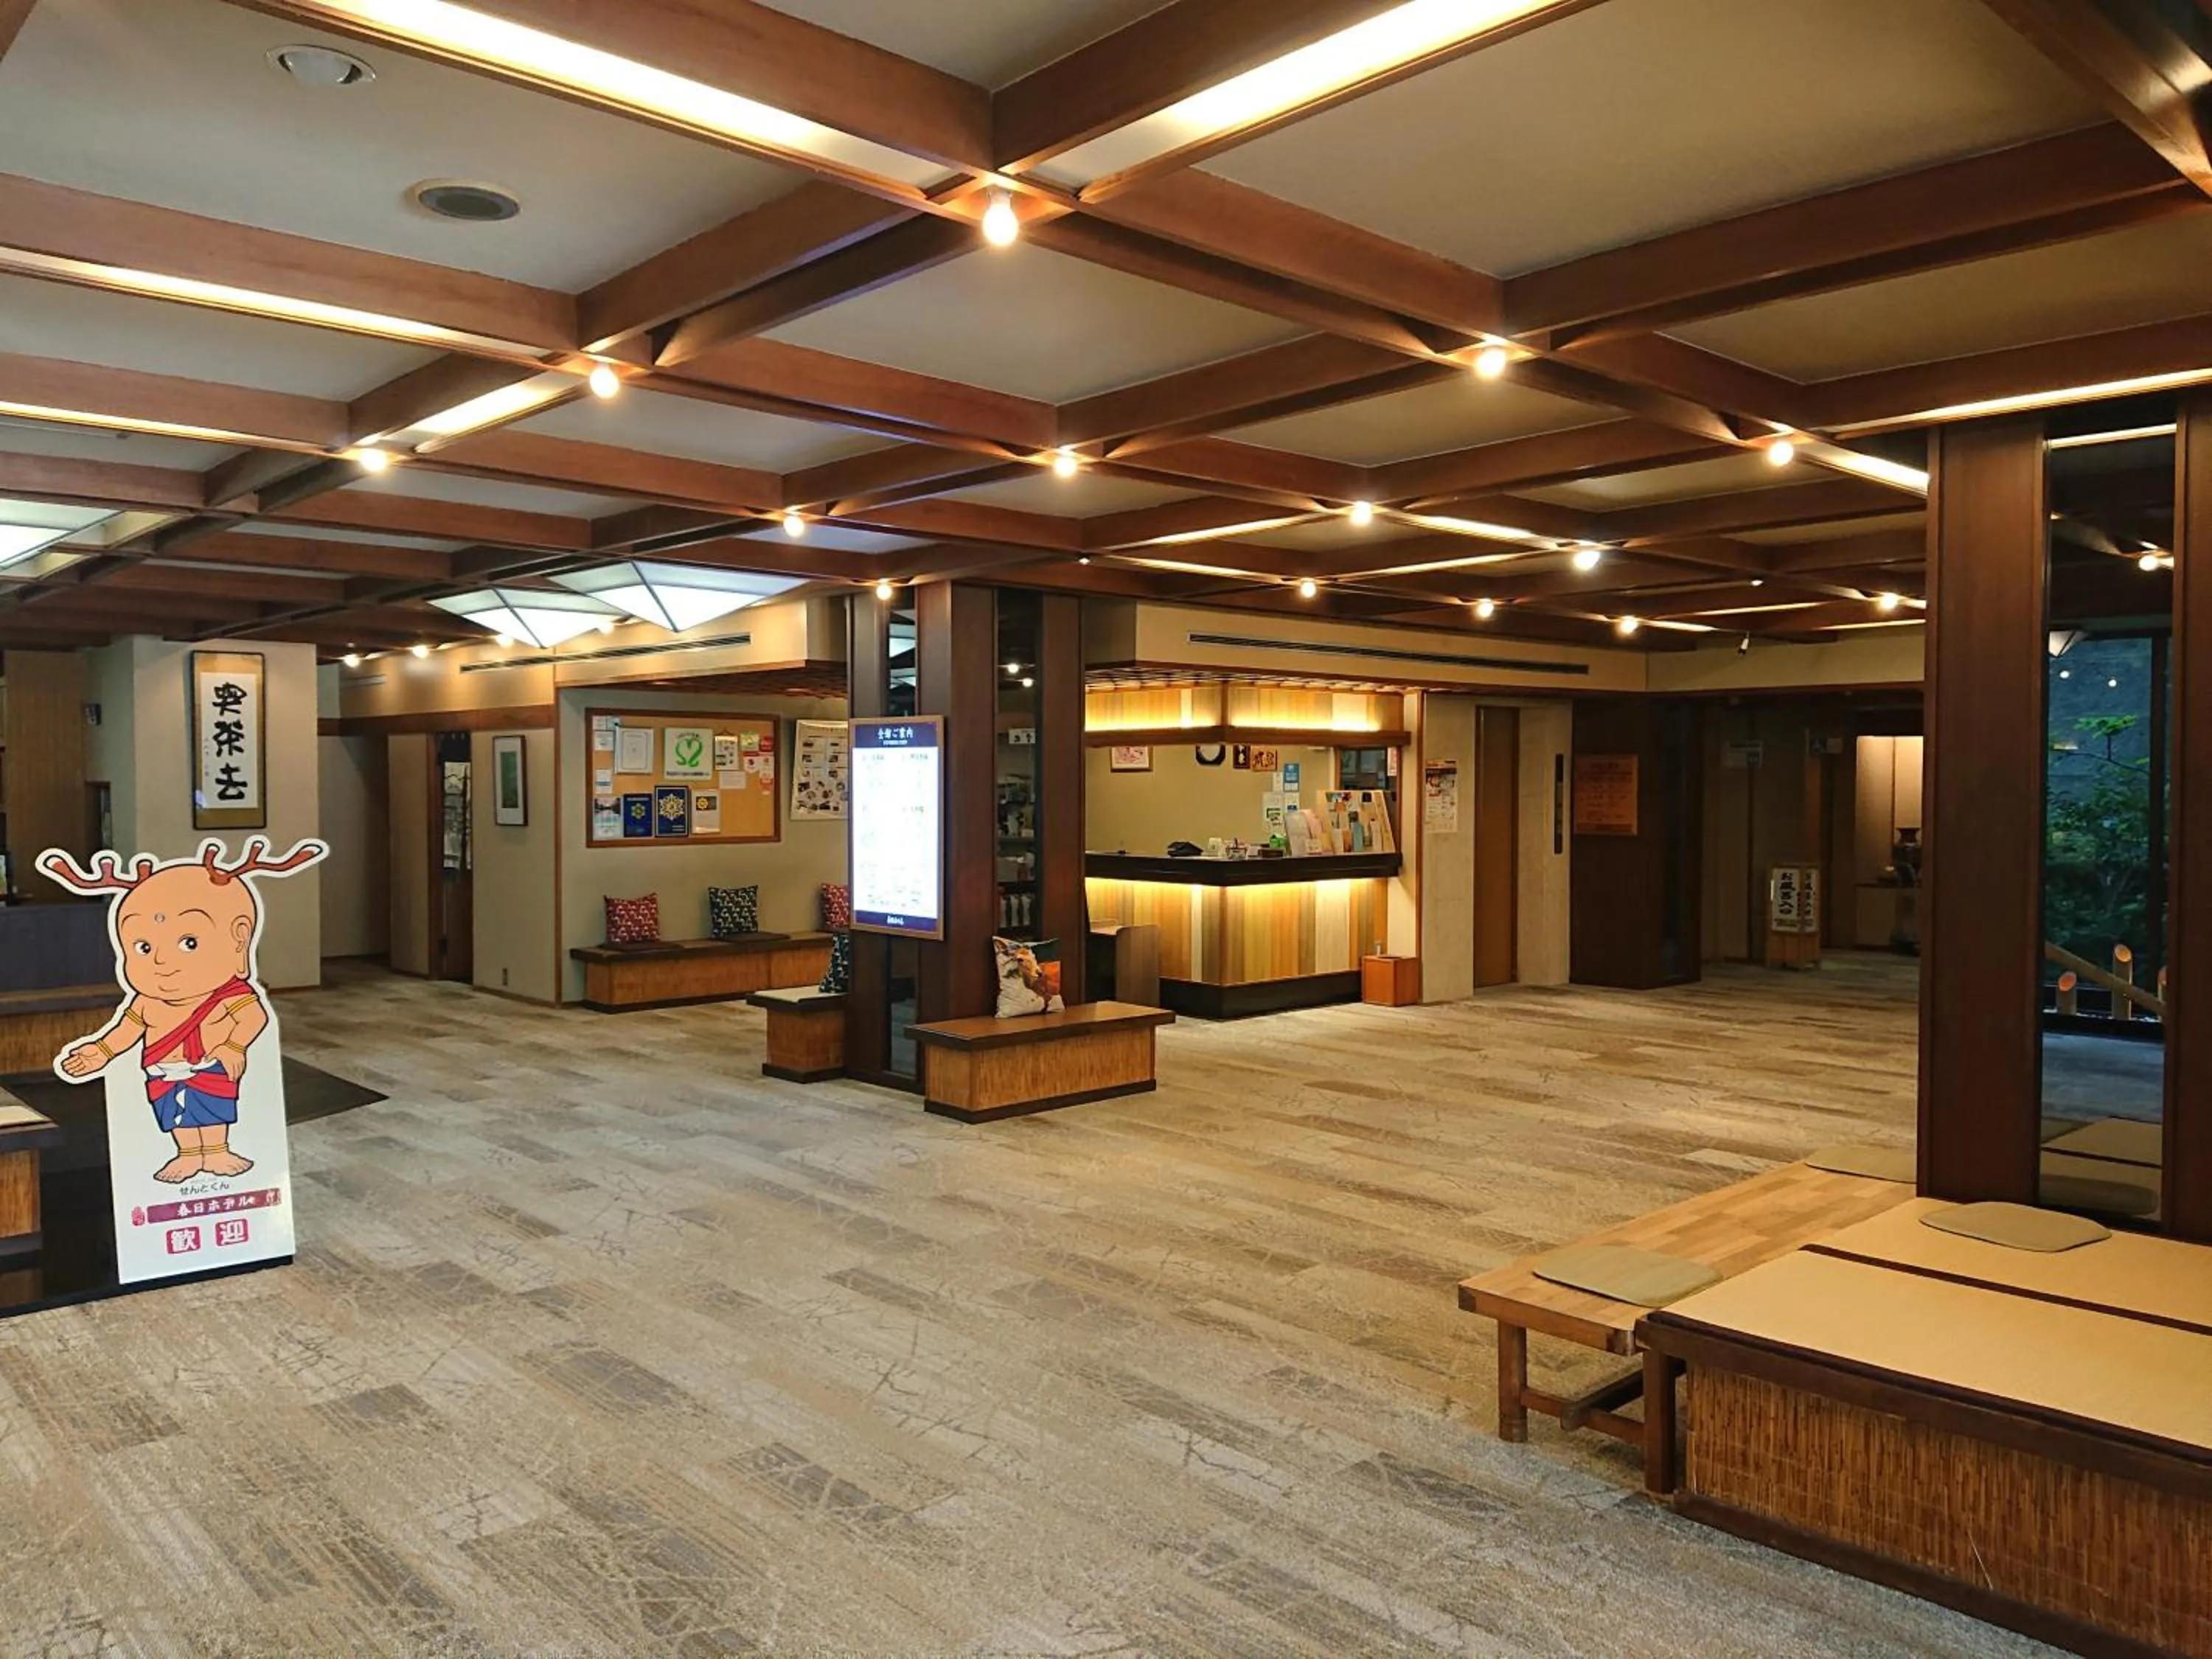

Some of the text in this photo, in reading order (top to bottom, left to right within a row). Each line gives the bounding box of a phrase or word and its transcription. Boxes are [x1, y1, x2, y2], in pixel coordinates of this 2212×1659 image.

[179, 1183, 230, 1196] せんとくん
